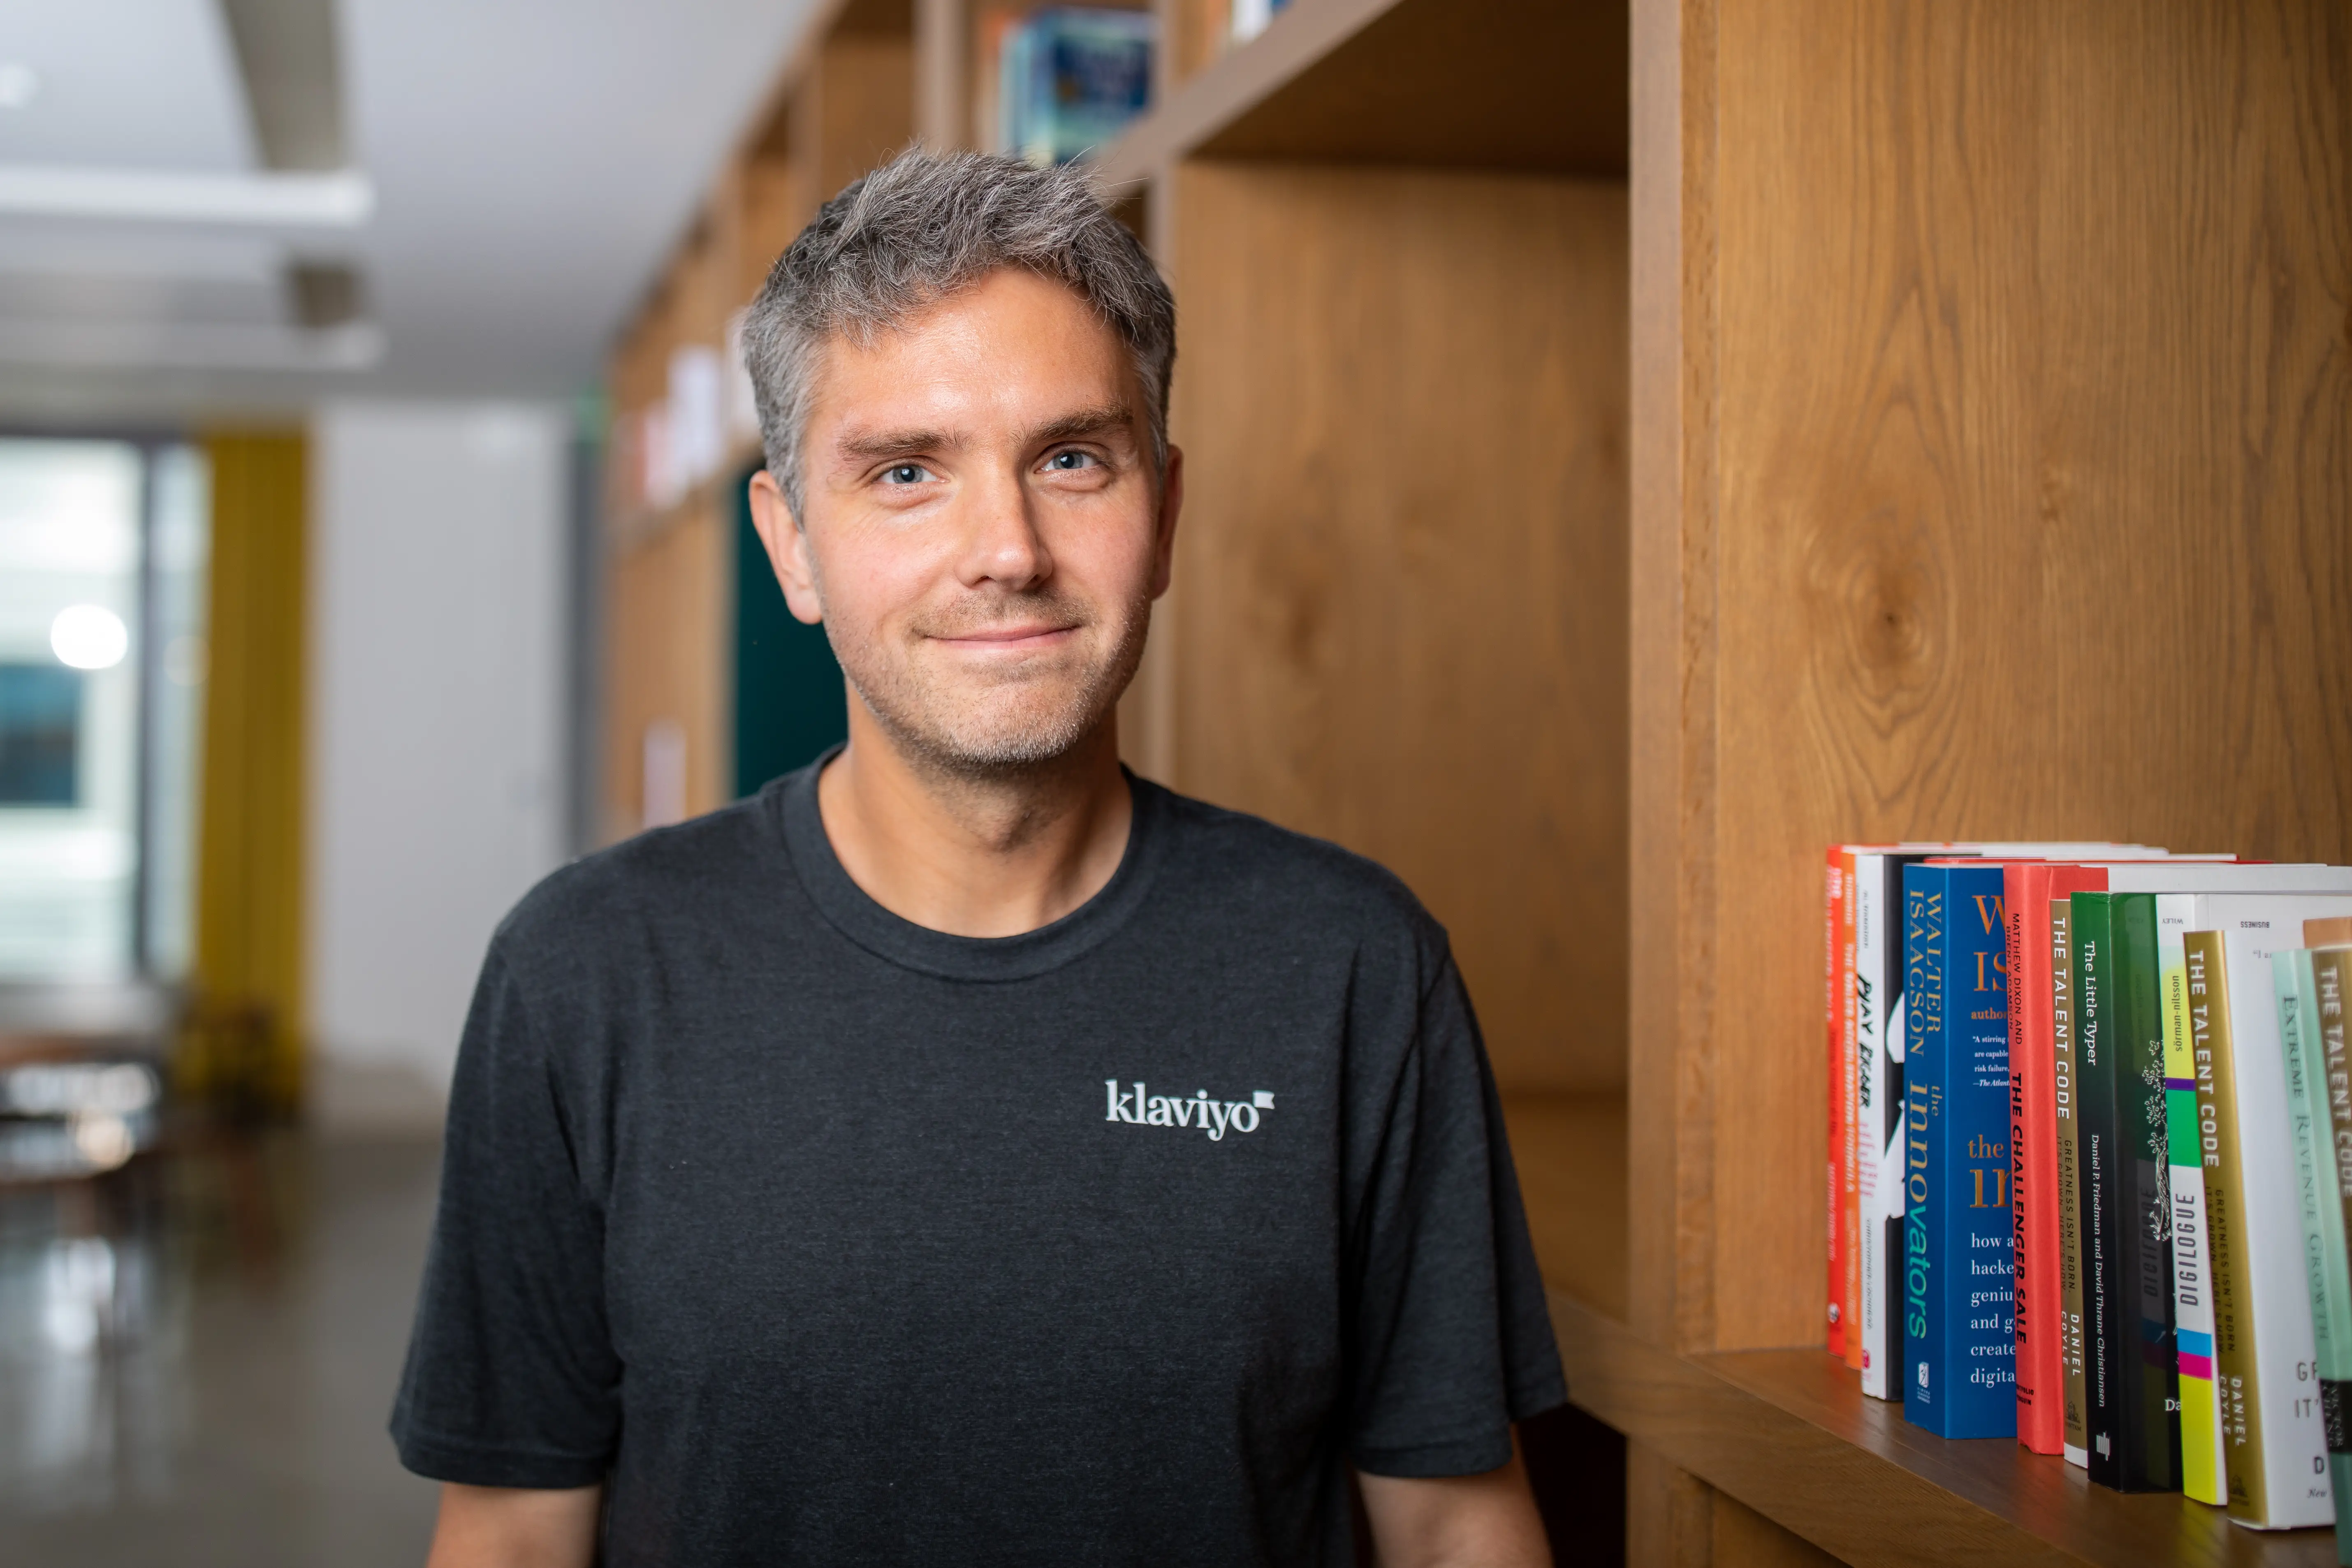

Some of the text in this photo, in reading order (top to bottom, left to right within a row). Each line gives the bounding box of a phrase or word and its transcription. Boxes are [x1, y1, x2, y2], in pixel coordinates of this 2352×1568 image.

[1909, 889, 1924, 1057] ISAACSON
[1927, 892, 1942, 1034] WALTER
[1856, 972, 1874, 1035] PLAY
[2053, 917, 2069, 1119] THE TALENT CODE
[2084, 941, 2097, 1065] The Little Typer
[2171, 976, 2182, 1052] sörman-nilsson
[2319, 968, 2341, 1017] THE
[1982, 1035, 2006, 1045] stirring
[1986, 1050, 2009, 1059] capable
[2190, 951, 2219, 1167] THE TALENT CODE
[1988, 1064, 2009, 1072] failure,
[2325, 1024, 2351, 1121] TALENT
[1105, 1079, 1260, 1141] klaviyo
[1931, 1085, 1942, 1116] the
[1967, 1134, 2004, 1158] the
[2092, 1134, 2100, 1170] Daniel
[2283, 994, 2328, 1340] EXTREME REVENUE GROWTH
[2065, 1140, 2073, 1212] GREATNESS
[1909, 1080, 1930, 1339] innovators
[2012, 1073, 2026, 1344] THE CHALLENGER SALE
[2093, 1183, 2102, 1234] Friedman
[1971, 1232, 2002, 1248] how
[1971, 1259, 2014, 1275] hacke
[2176, 1193, 2198, 1306] DIGILOGUE
[2216, 1189, 2229, 1268] GREATNESS
[2223, 1274, 2232, 1309] ISN'T
[1971, 1286, 2013, 1308] geniu
[2095, 1262, 2104, 1293] David
[1970, 1344, 2016, 1356] create
[1971, 1313, 2016, 1334] and g
[2071, 1314, 2081, 1376] DANIEL
[1970, 1368, 2015, 1388] digita
[2164, 1399, 2181, 1411] Da
[2220, 1375, 2231, 1435] COYLE
[2231, 1377, 2246, 1446] DANIEL
[2313, 1457, 2324, 1474] D
[2307, 1489, 2327, 1498] New
